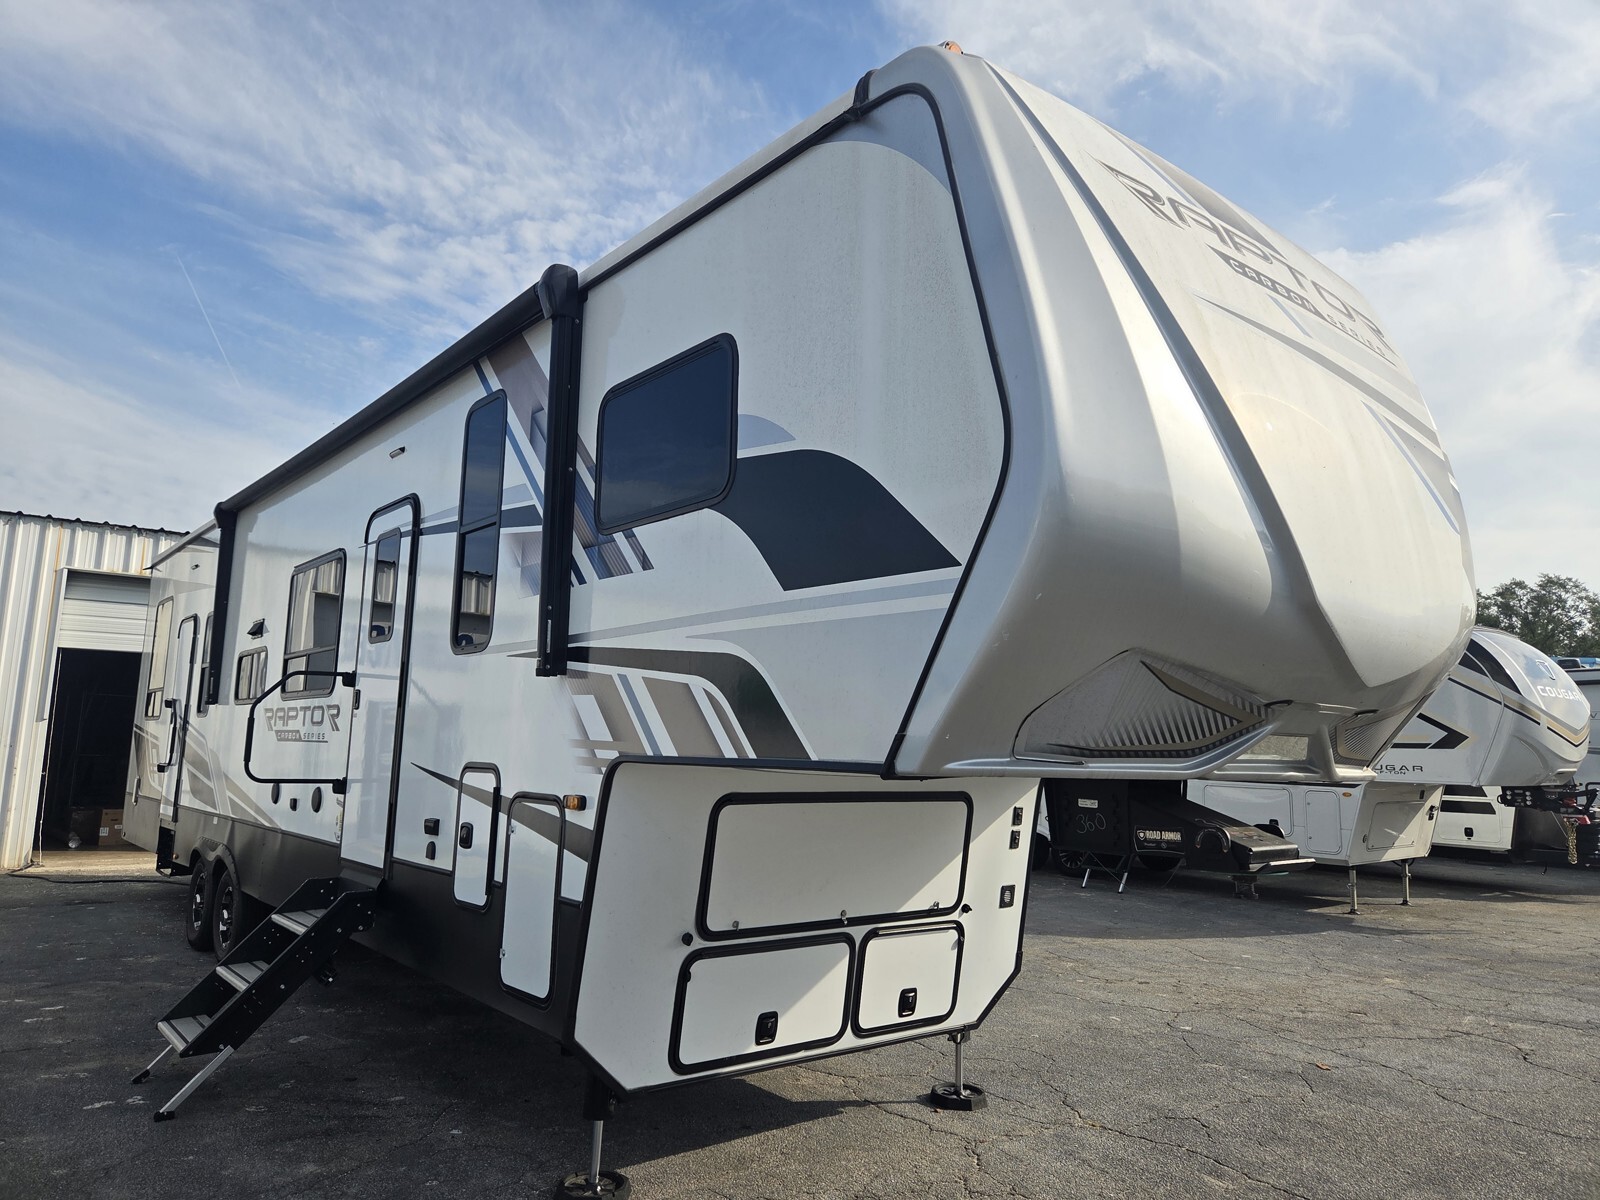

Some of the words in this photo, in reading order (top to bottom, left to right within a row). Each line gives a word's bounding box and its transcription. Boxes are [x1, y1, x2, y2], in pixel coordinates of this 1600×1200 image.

[1092, 155, 1400, 358] RAPTOR
[1228, 259, 1316, 313] CARBON
[1326, 313, 1386, 357] SERIES
[1536, 685, 1582, 702] COUGAR
[264, 704, 341, 732] RAPTOR
[302, 732, 326, 740] SERIES
[1374, 764, 1424, 772] UGAR
[1076, 812, 1107, 834] 360
[1145, 830, 1161, 840] ROAD
[1161, 831, 1182, 841] ARMOR
